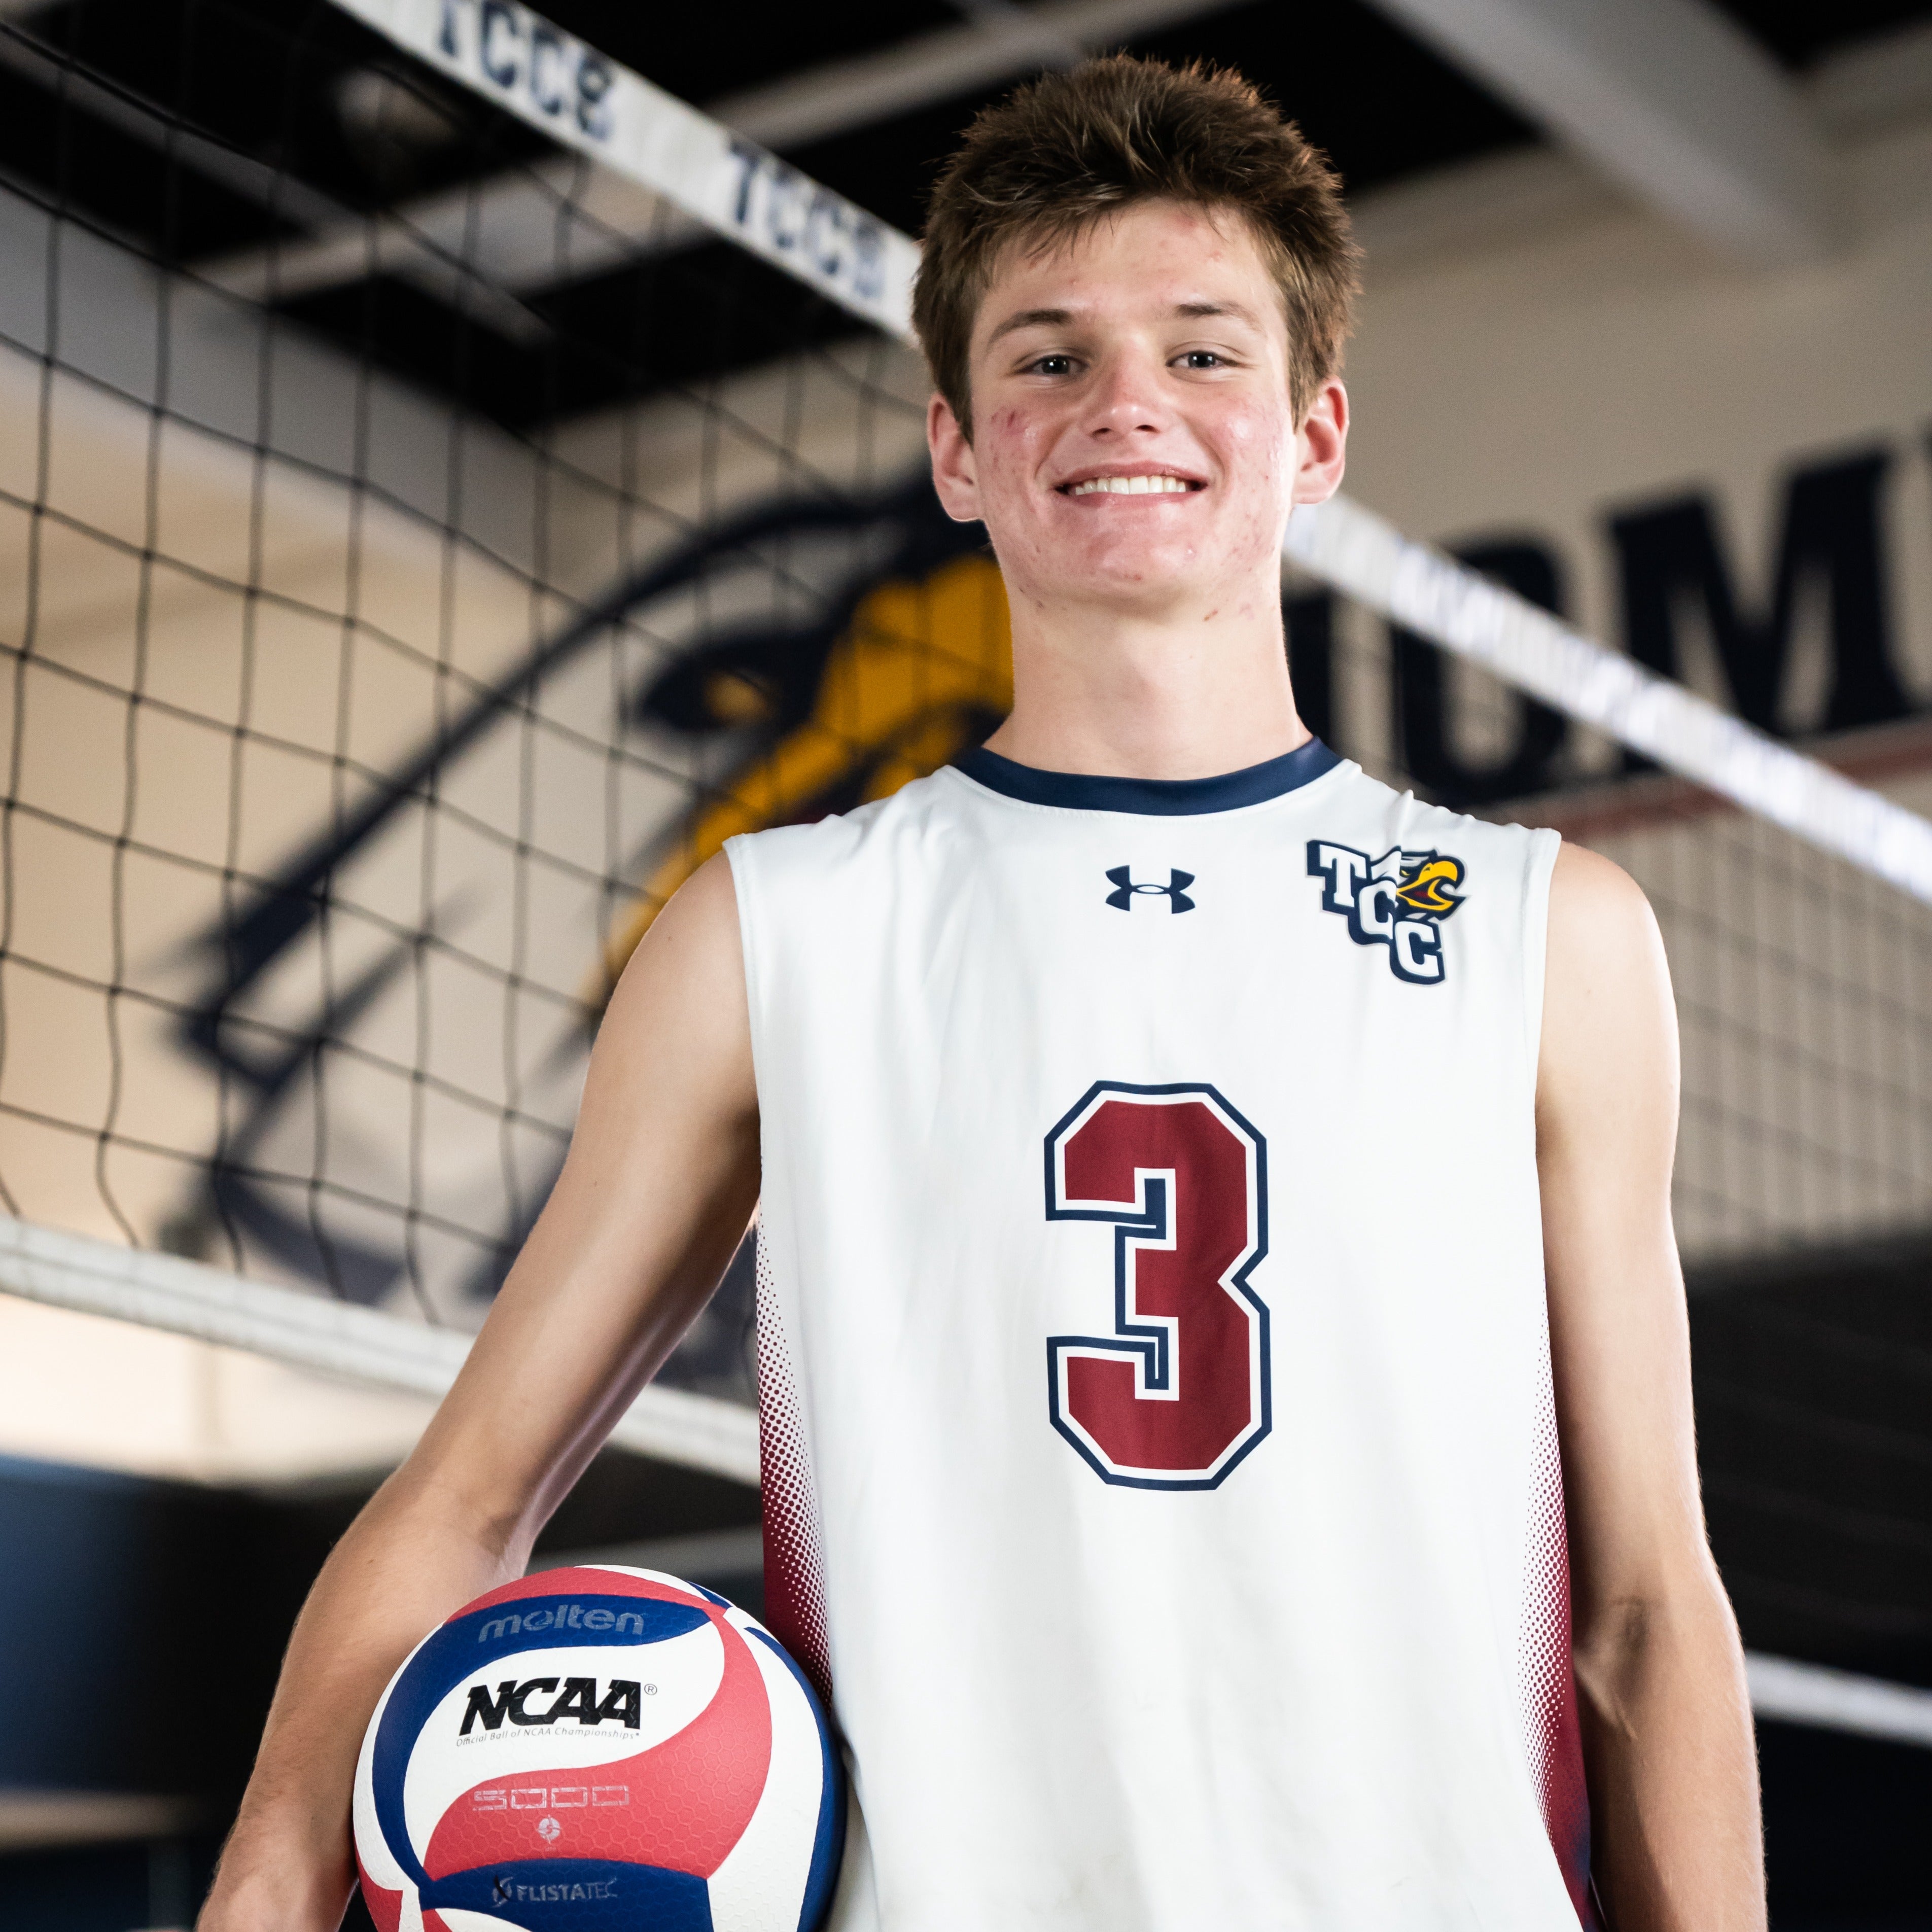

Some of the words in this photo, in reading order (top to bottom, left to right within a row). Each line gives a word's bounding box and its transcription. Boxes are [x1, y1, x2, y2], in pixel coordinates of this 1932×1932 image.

[1043, 1080, 1273, 1491] 3
[478, 1604, 645, 1644] molten
[456, 1732, 487, 1747] Official
[489, 1731, 508, 1741] Ball
[510, 1728, 521, 1738] of
[523, 1728, 551, 1737] NCAA
[472, 1785, 629, 1811] 5000
[516, 1876, 618, 1902] FLISTATEC
